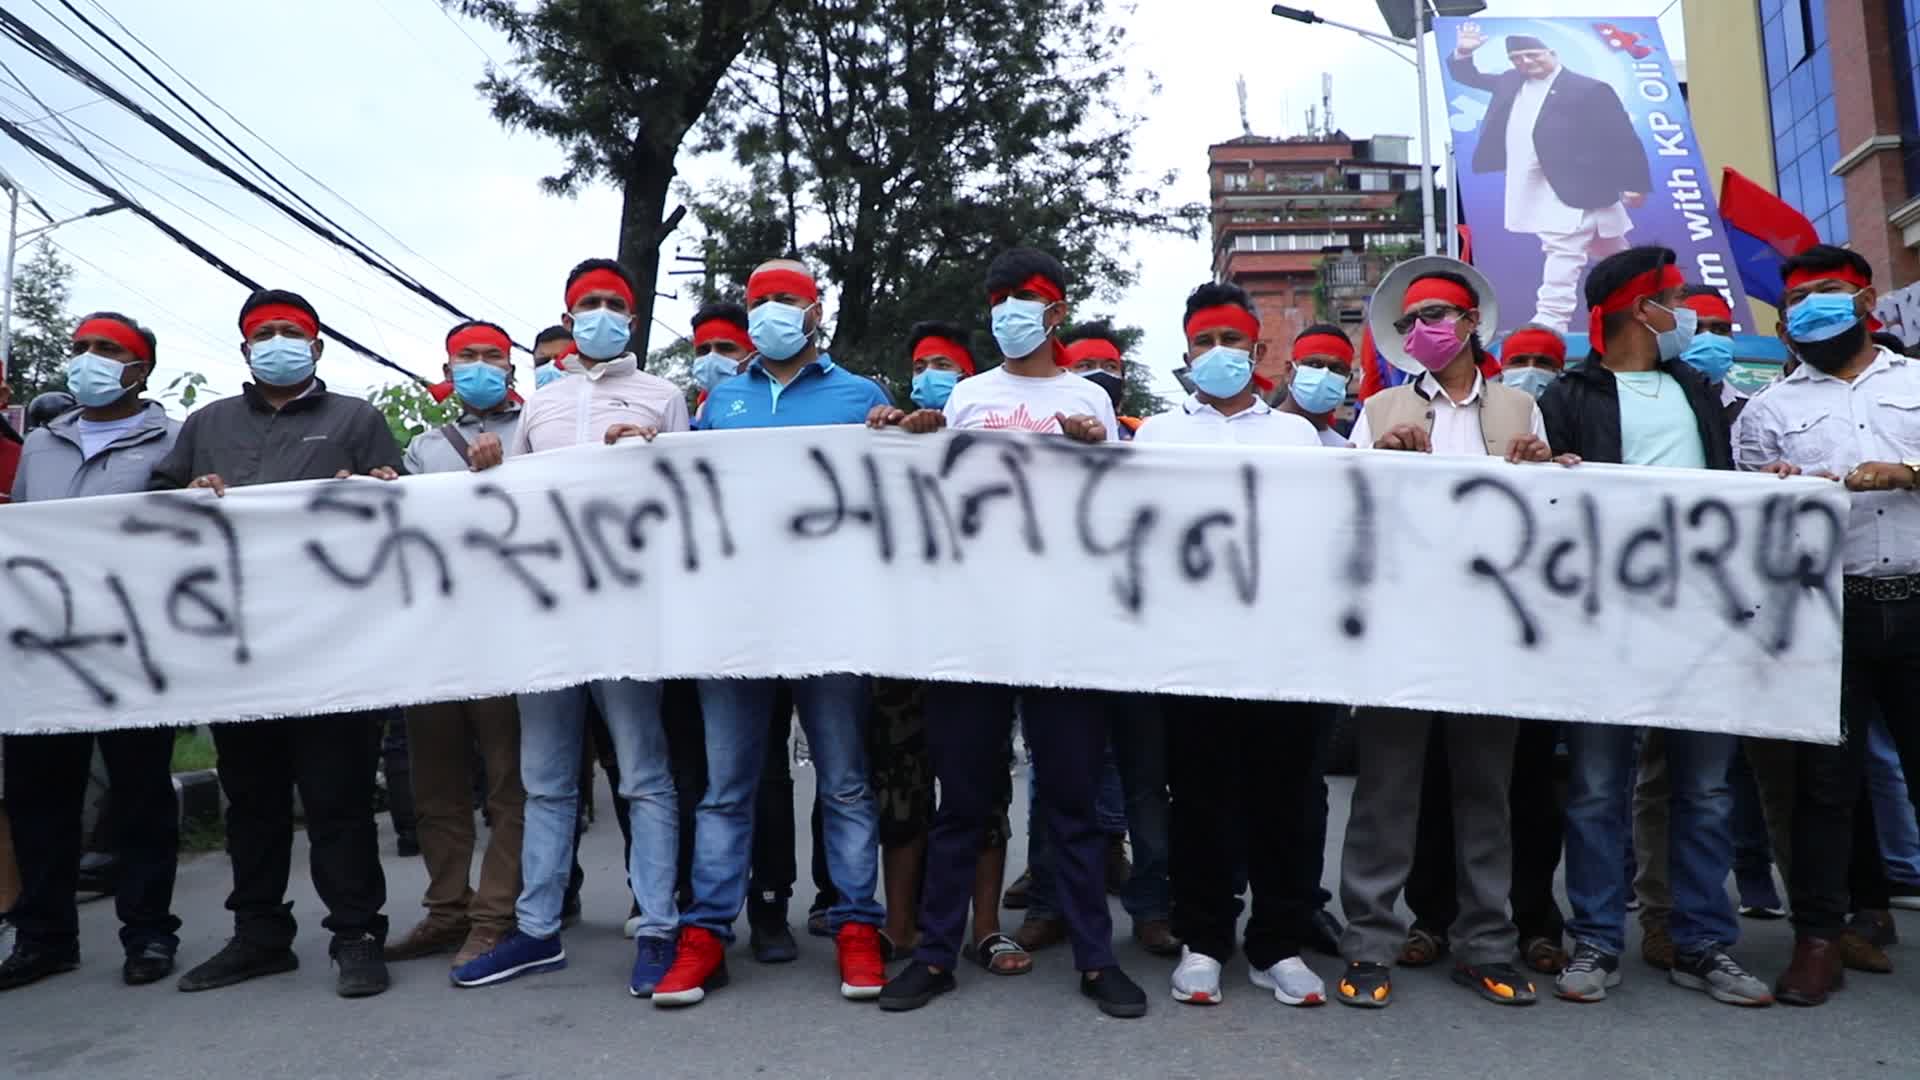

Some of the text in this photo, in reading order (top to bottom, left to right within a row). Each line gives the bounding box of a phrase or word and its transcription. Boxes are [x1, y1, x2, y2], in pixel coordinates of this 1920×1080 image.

[1633, 62, 1670, 103] Oli
[1648, 111, 1689, 156] KP
[1667, 167, 1713, 242] with
